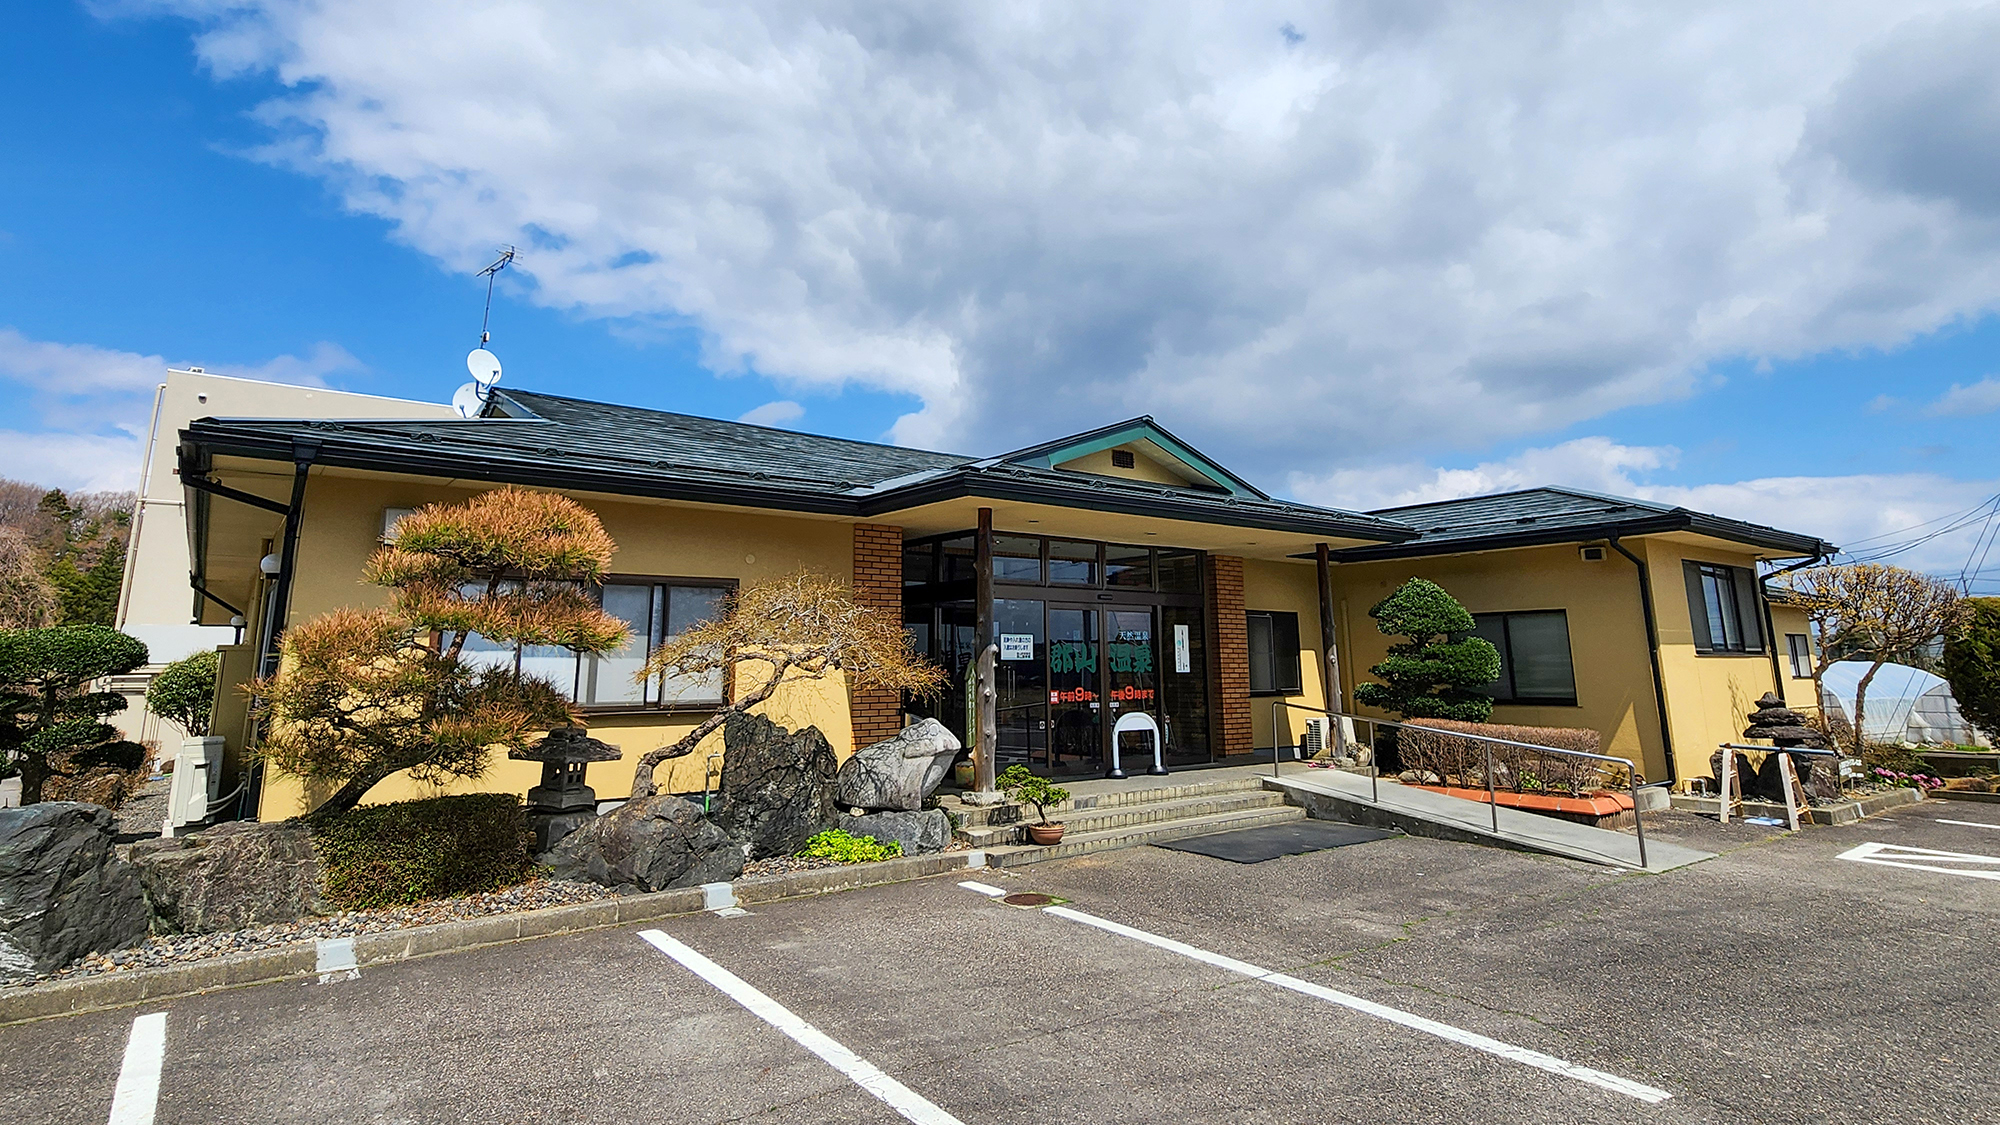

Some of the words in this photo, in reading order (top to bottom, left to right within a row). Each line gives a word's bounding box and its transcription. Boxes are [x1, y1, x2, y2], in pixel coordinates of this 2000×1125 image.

[1119, 630, 1149, 641] 天然温泉
[1050, 643, 1096, 673] 郡山
[1110, 644, 1152, 673] 温泉
[1111, 686, 1154, 700] 午後9時まで
